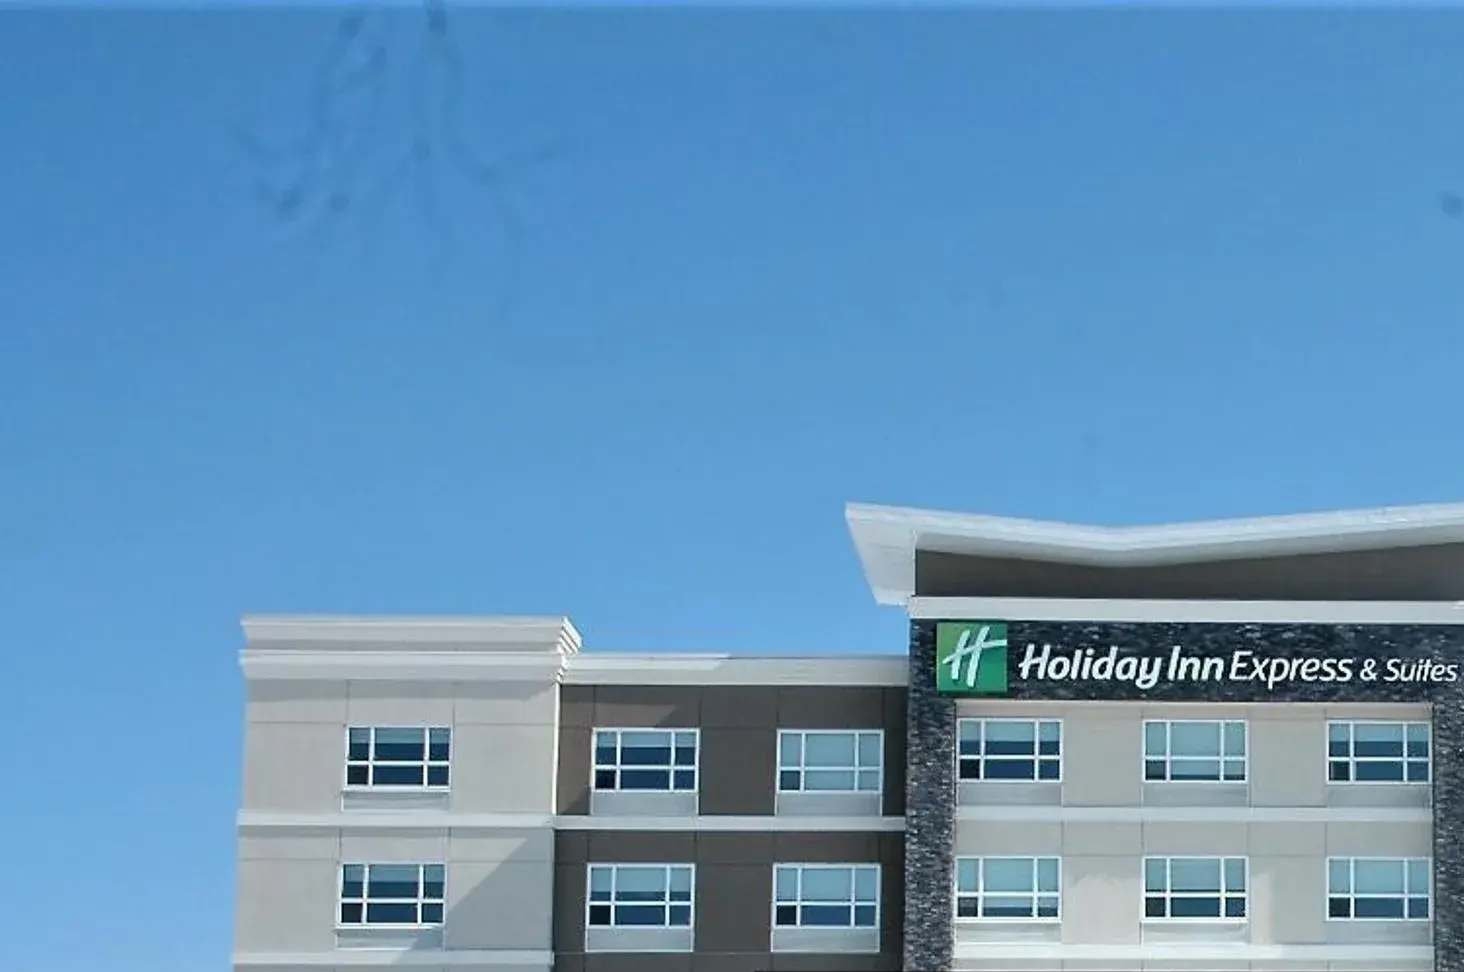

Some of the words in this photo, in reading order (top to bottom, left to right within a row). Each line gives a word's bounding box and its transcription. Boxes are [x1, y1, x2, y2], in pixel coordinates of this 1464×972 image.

[1018, 643, 1167, 689] Holiday
[1168, 644, 1224, 681] Inn
[1229, 650, 1353, 689] Express
[1359, 657, 1377, 680] &
[1384, 656, 1458, 682] Suites
